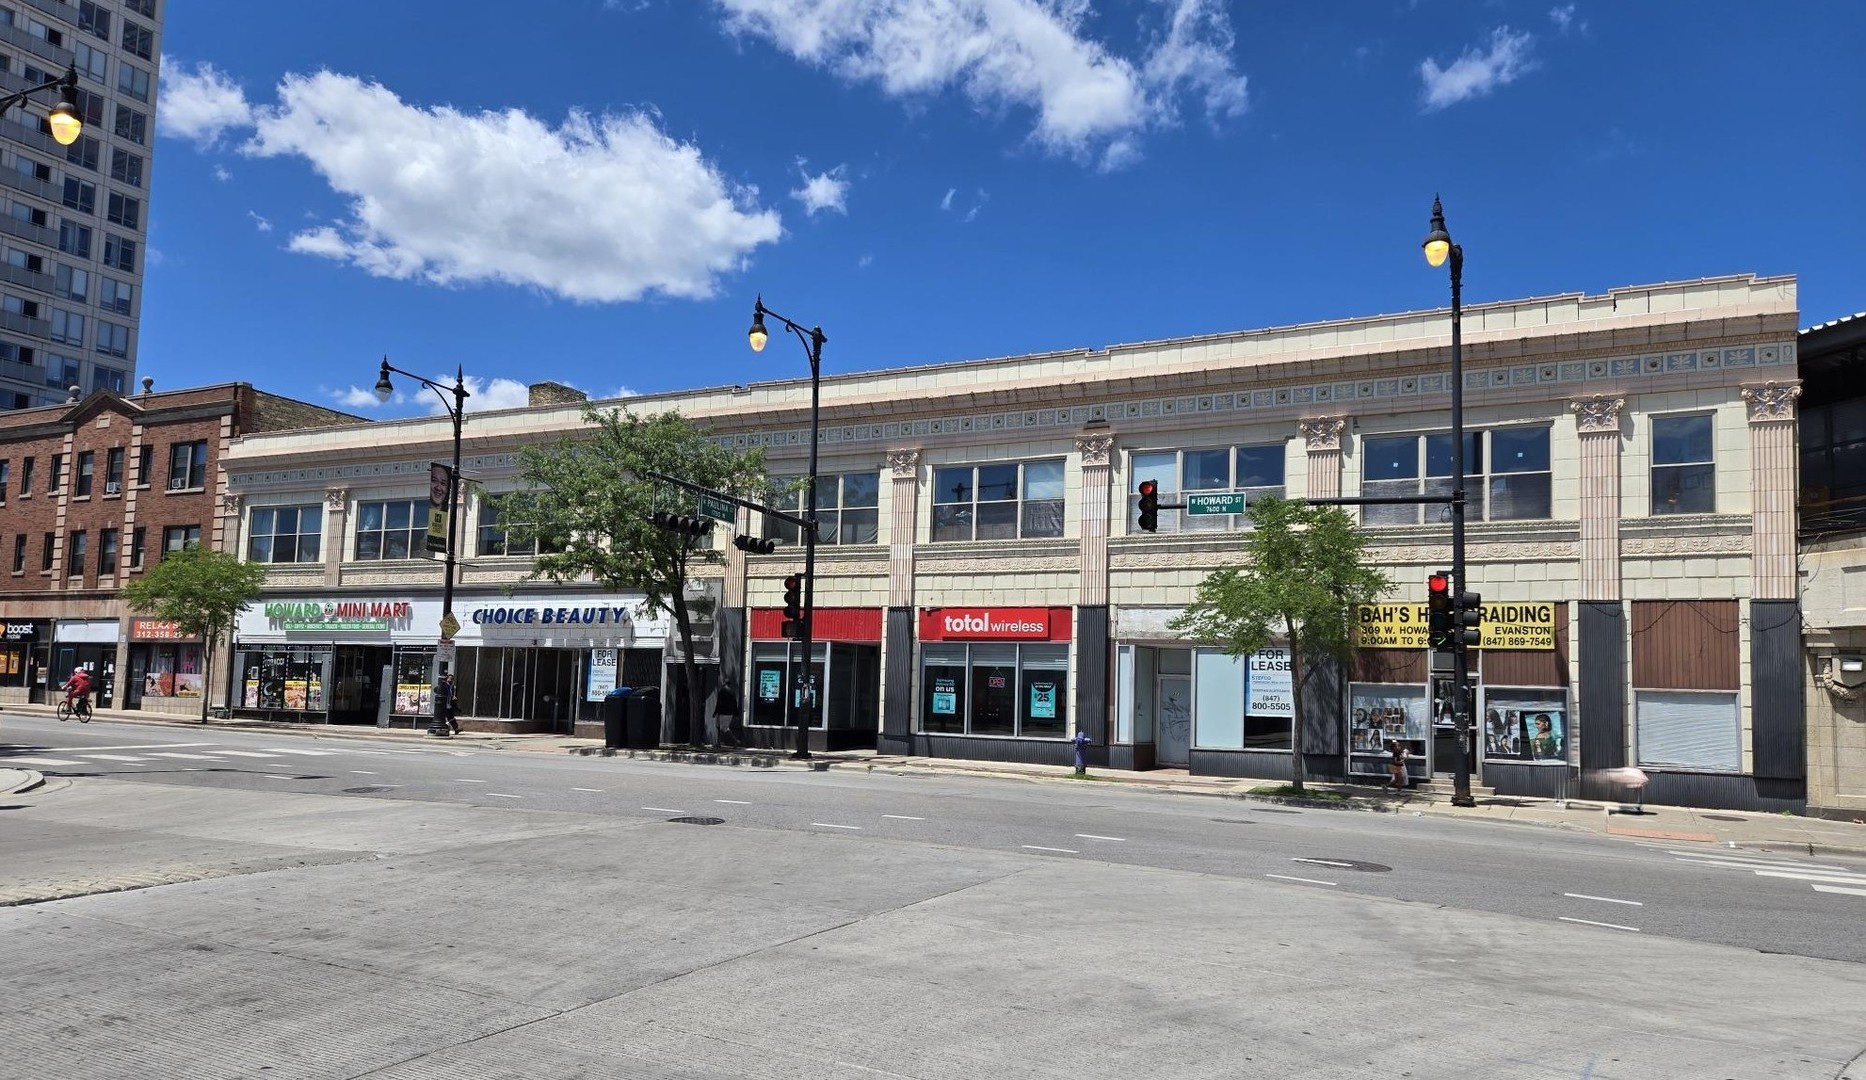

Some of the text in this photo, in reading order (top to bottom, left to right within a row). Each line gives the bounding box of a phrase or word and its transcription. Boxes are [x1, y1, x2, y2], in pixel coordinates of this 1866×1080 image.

[1197, 496, 1234, 506] HOWARD
[264, 602, 409, 618] HOWARD MINI MART
[1361, 606, 1410, 623] BAH'S
[1479, 605, 1551, 623] RAIDING
[472, 607, 535, 625] CHOICE
[541, 607, 626, 624] BEAUTY
[140, 621, 170, 630] RELAX
[944, 612, 1044, 632] total wireless
[7, 623, 33, 634] boost
[1361, 626, 1551, 635] 309 W. HOWA EVANSTON
[1361, 636, 1398, 645] 9:00AM
[1402, 637, 1413, 645] TO
[1483, 637, 1506, 646] (847)
[1508, 637, 1552, 646] 869-7549
[597, 650, 613, 658] FOR
[1258, 650, 1284, 660] FOR
[592, 659, 616, 667] LEASE
[1251, 661, 1292, 671] LEASE
[1262, 694, 1280, 702] (847)
[1252, 702, 1291, 711] 800-5505
